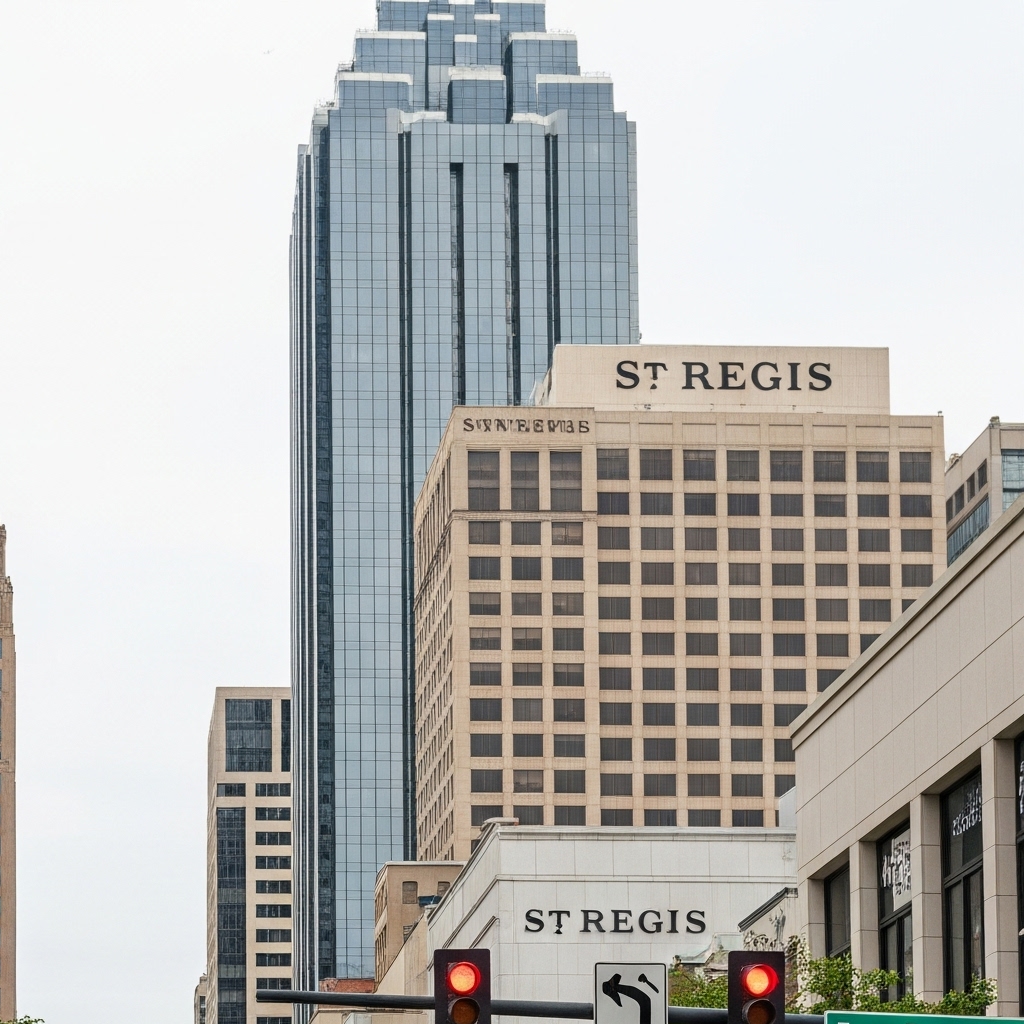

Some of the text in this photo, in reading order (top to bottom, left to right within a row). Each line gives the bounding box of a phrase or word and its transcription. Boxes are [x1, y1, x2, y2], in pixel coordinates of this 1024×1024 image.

[681, 361, 832, 391] REGIS
[525, 909, 706, 934] ST REGIS
